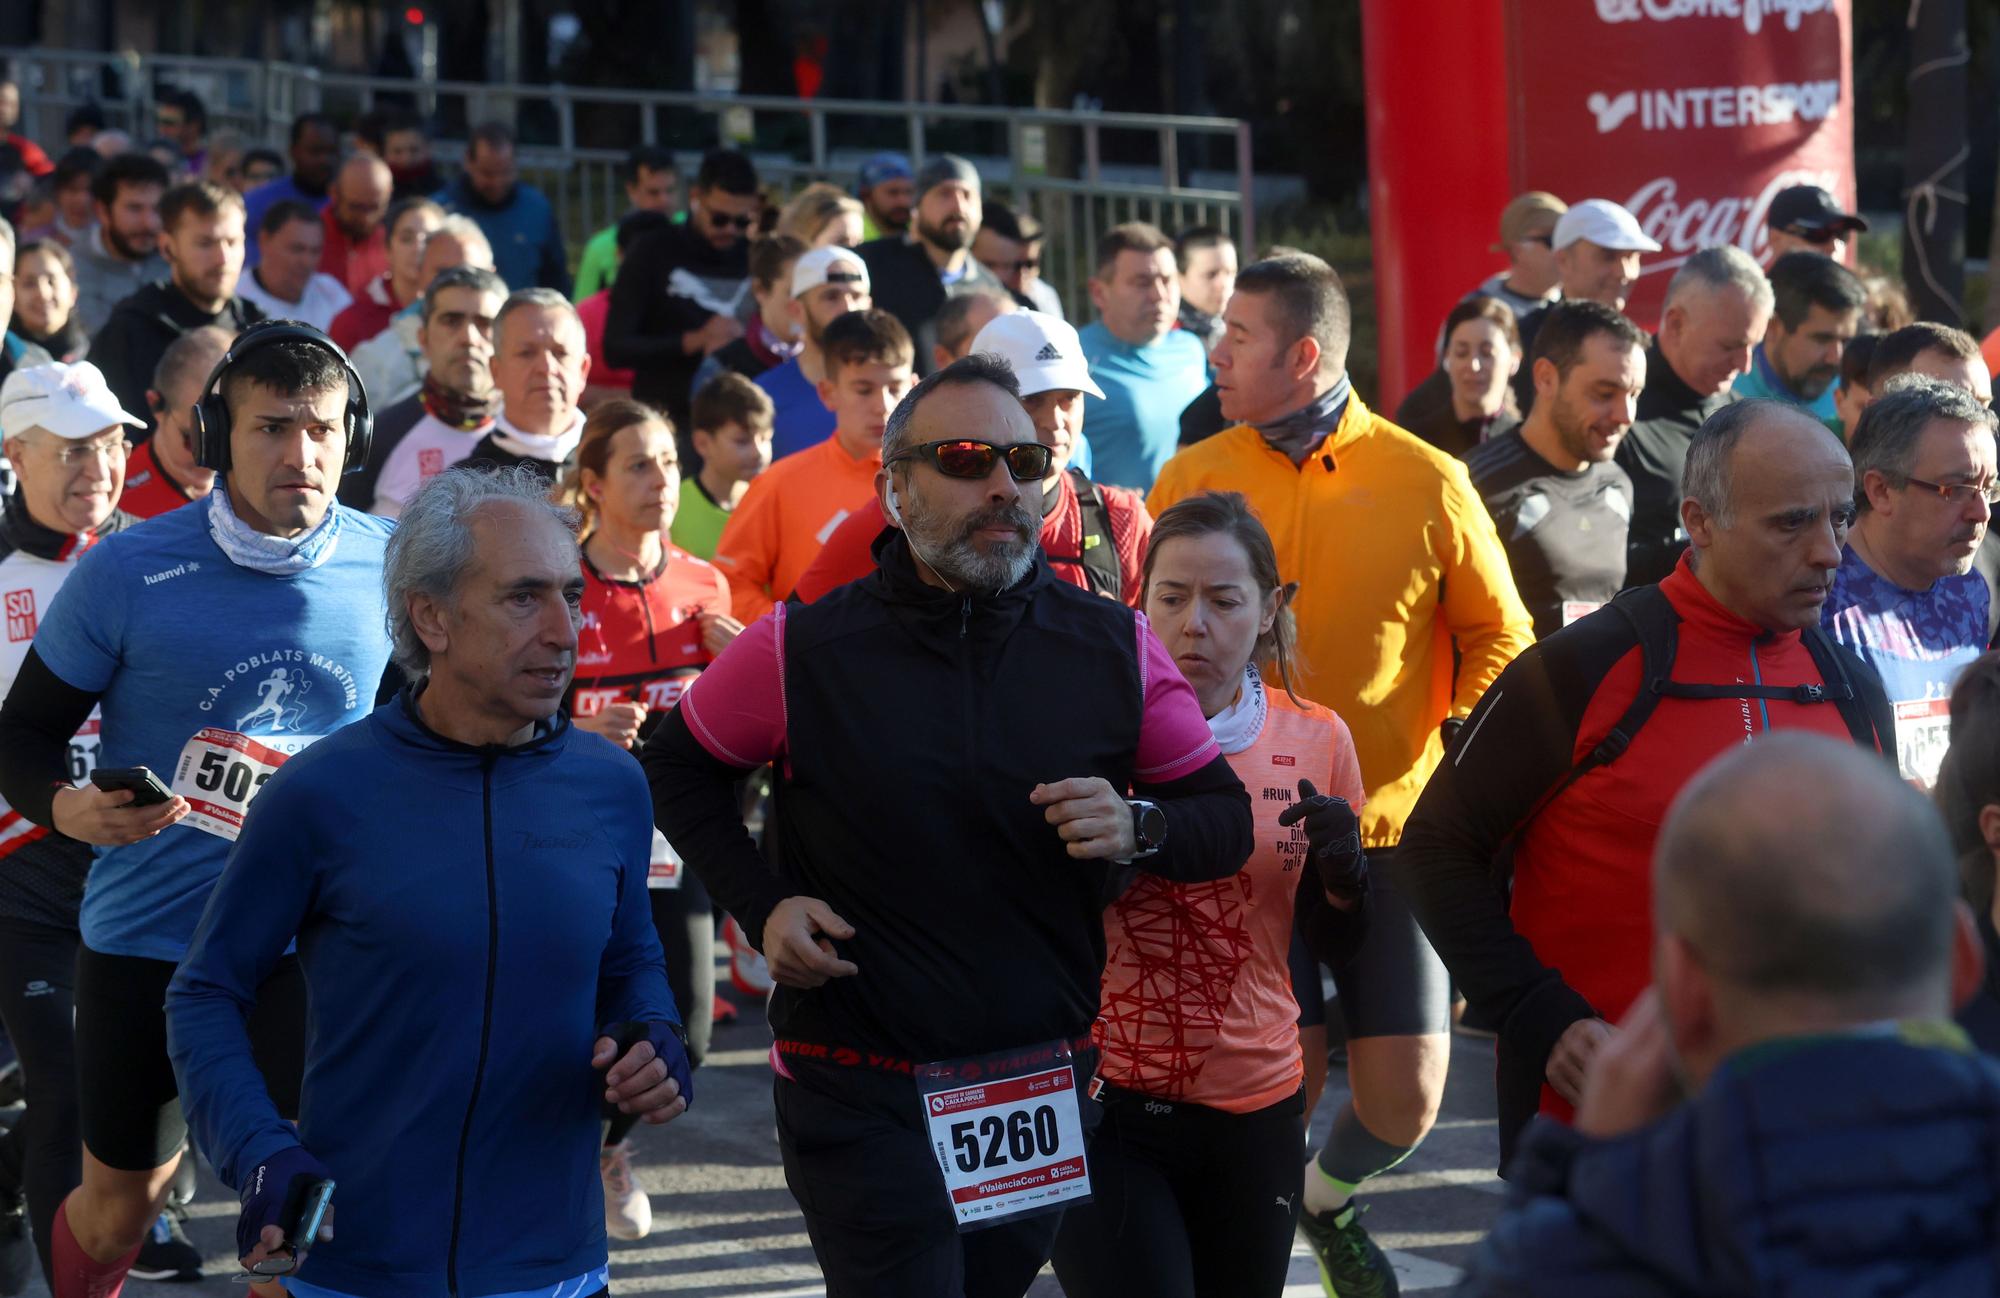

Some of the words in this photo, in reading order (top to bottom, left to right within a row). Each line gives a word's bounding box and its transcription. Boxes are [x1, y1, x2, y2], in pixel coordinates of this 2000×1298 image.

[1624, 171, 1840, 268] Coca-C
[144, 564, 186, 586] luanvi
[7, 591, 34, 618] SO
[224, 649, 304, 682] POBLATS
[309, 652, 357, 711] MARÍTIMS
[645, 681, 684, 709] TE
[1736, 677, 1752, 732] RAIDLIT
[196, 751, 272, 805] 50
[1262, 788, 1292, 801] #RUN
[779, 1040, 830, 1058] IATOR
[950, 1104, 1059, 1173] 5260
[978, 1173, 1046, 1195] #ValènciaCorre
